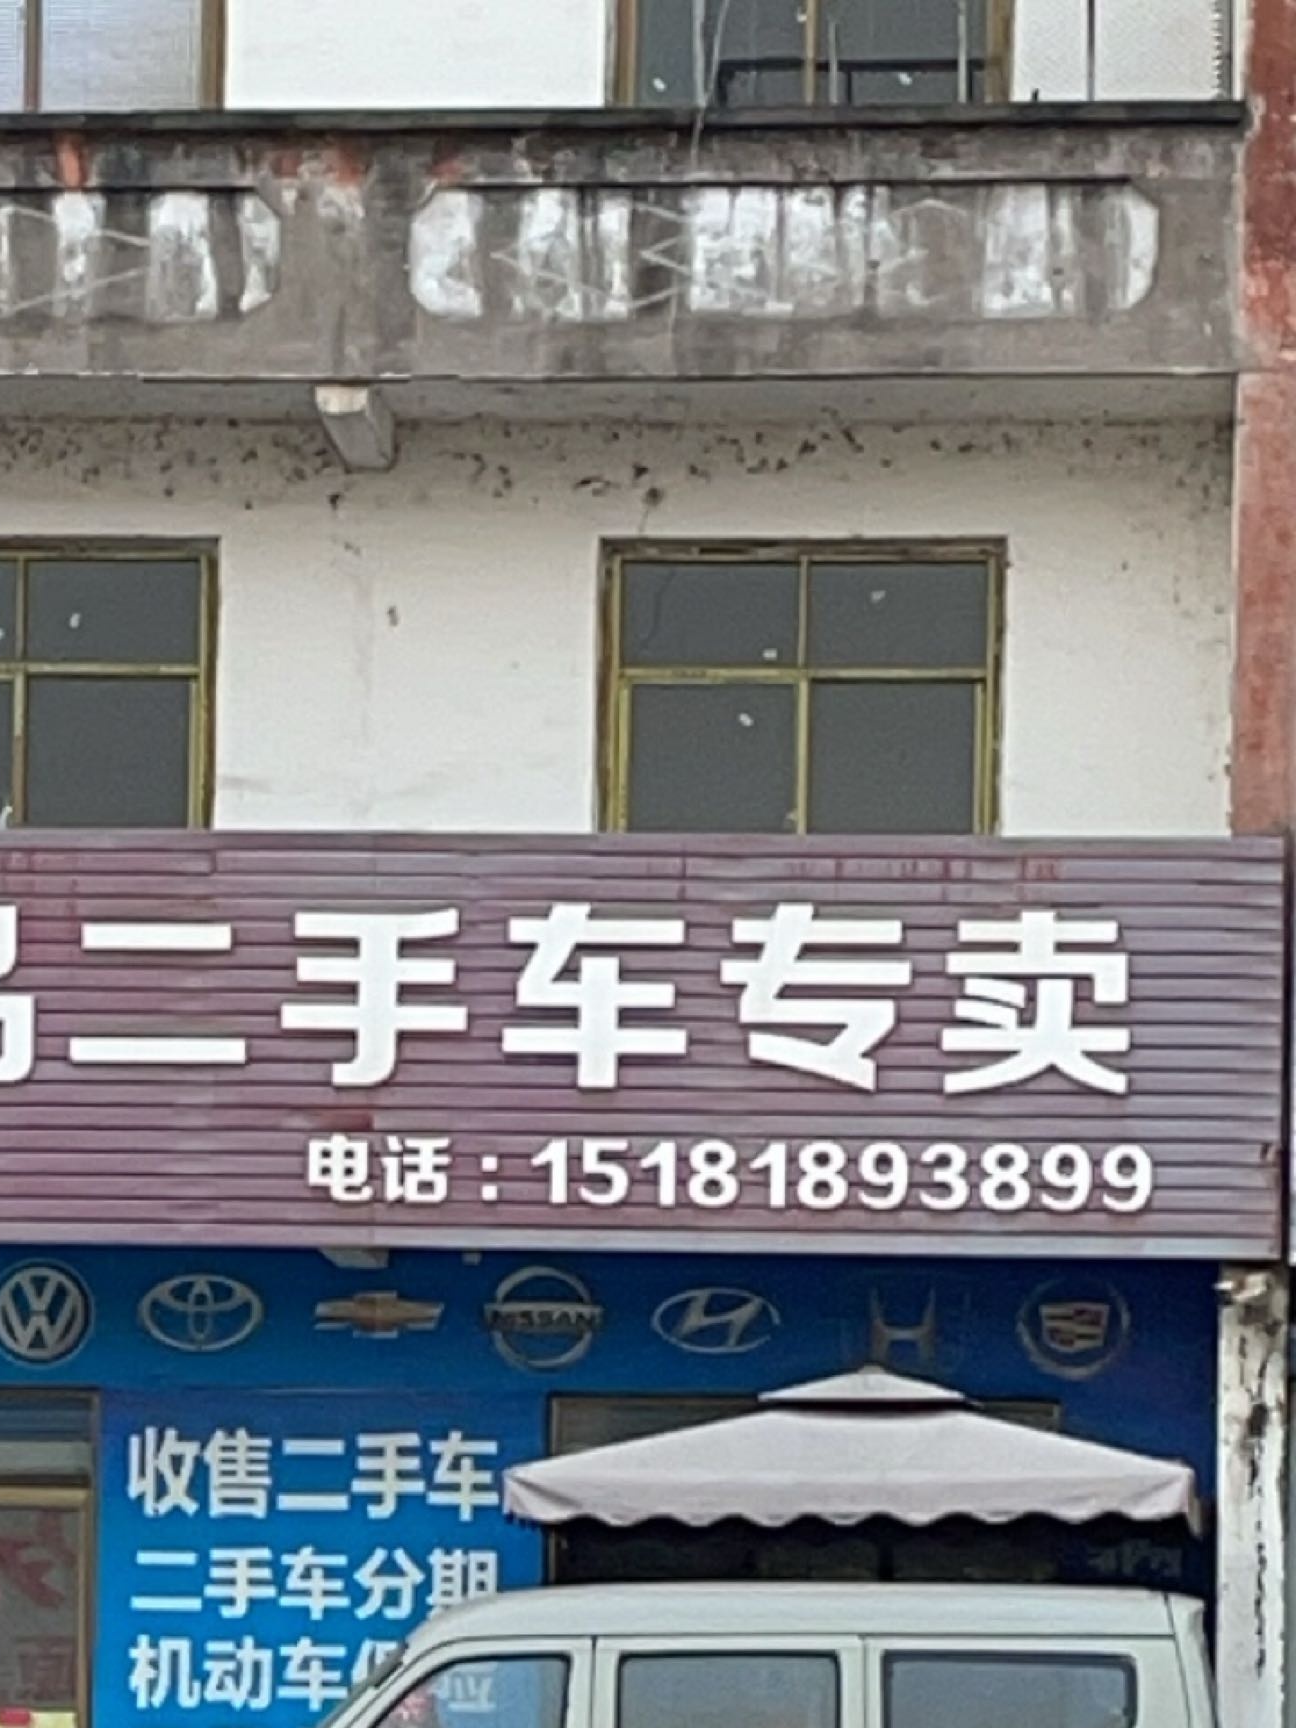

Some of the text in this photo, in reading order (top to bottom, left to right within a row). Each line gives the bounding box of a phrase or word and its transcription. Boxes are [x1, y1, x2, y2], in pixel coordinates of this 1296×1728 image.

[127, 1425, 499, 1522] 收售二手车
[130, 1546, 499, 1620] 二手车分期
